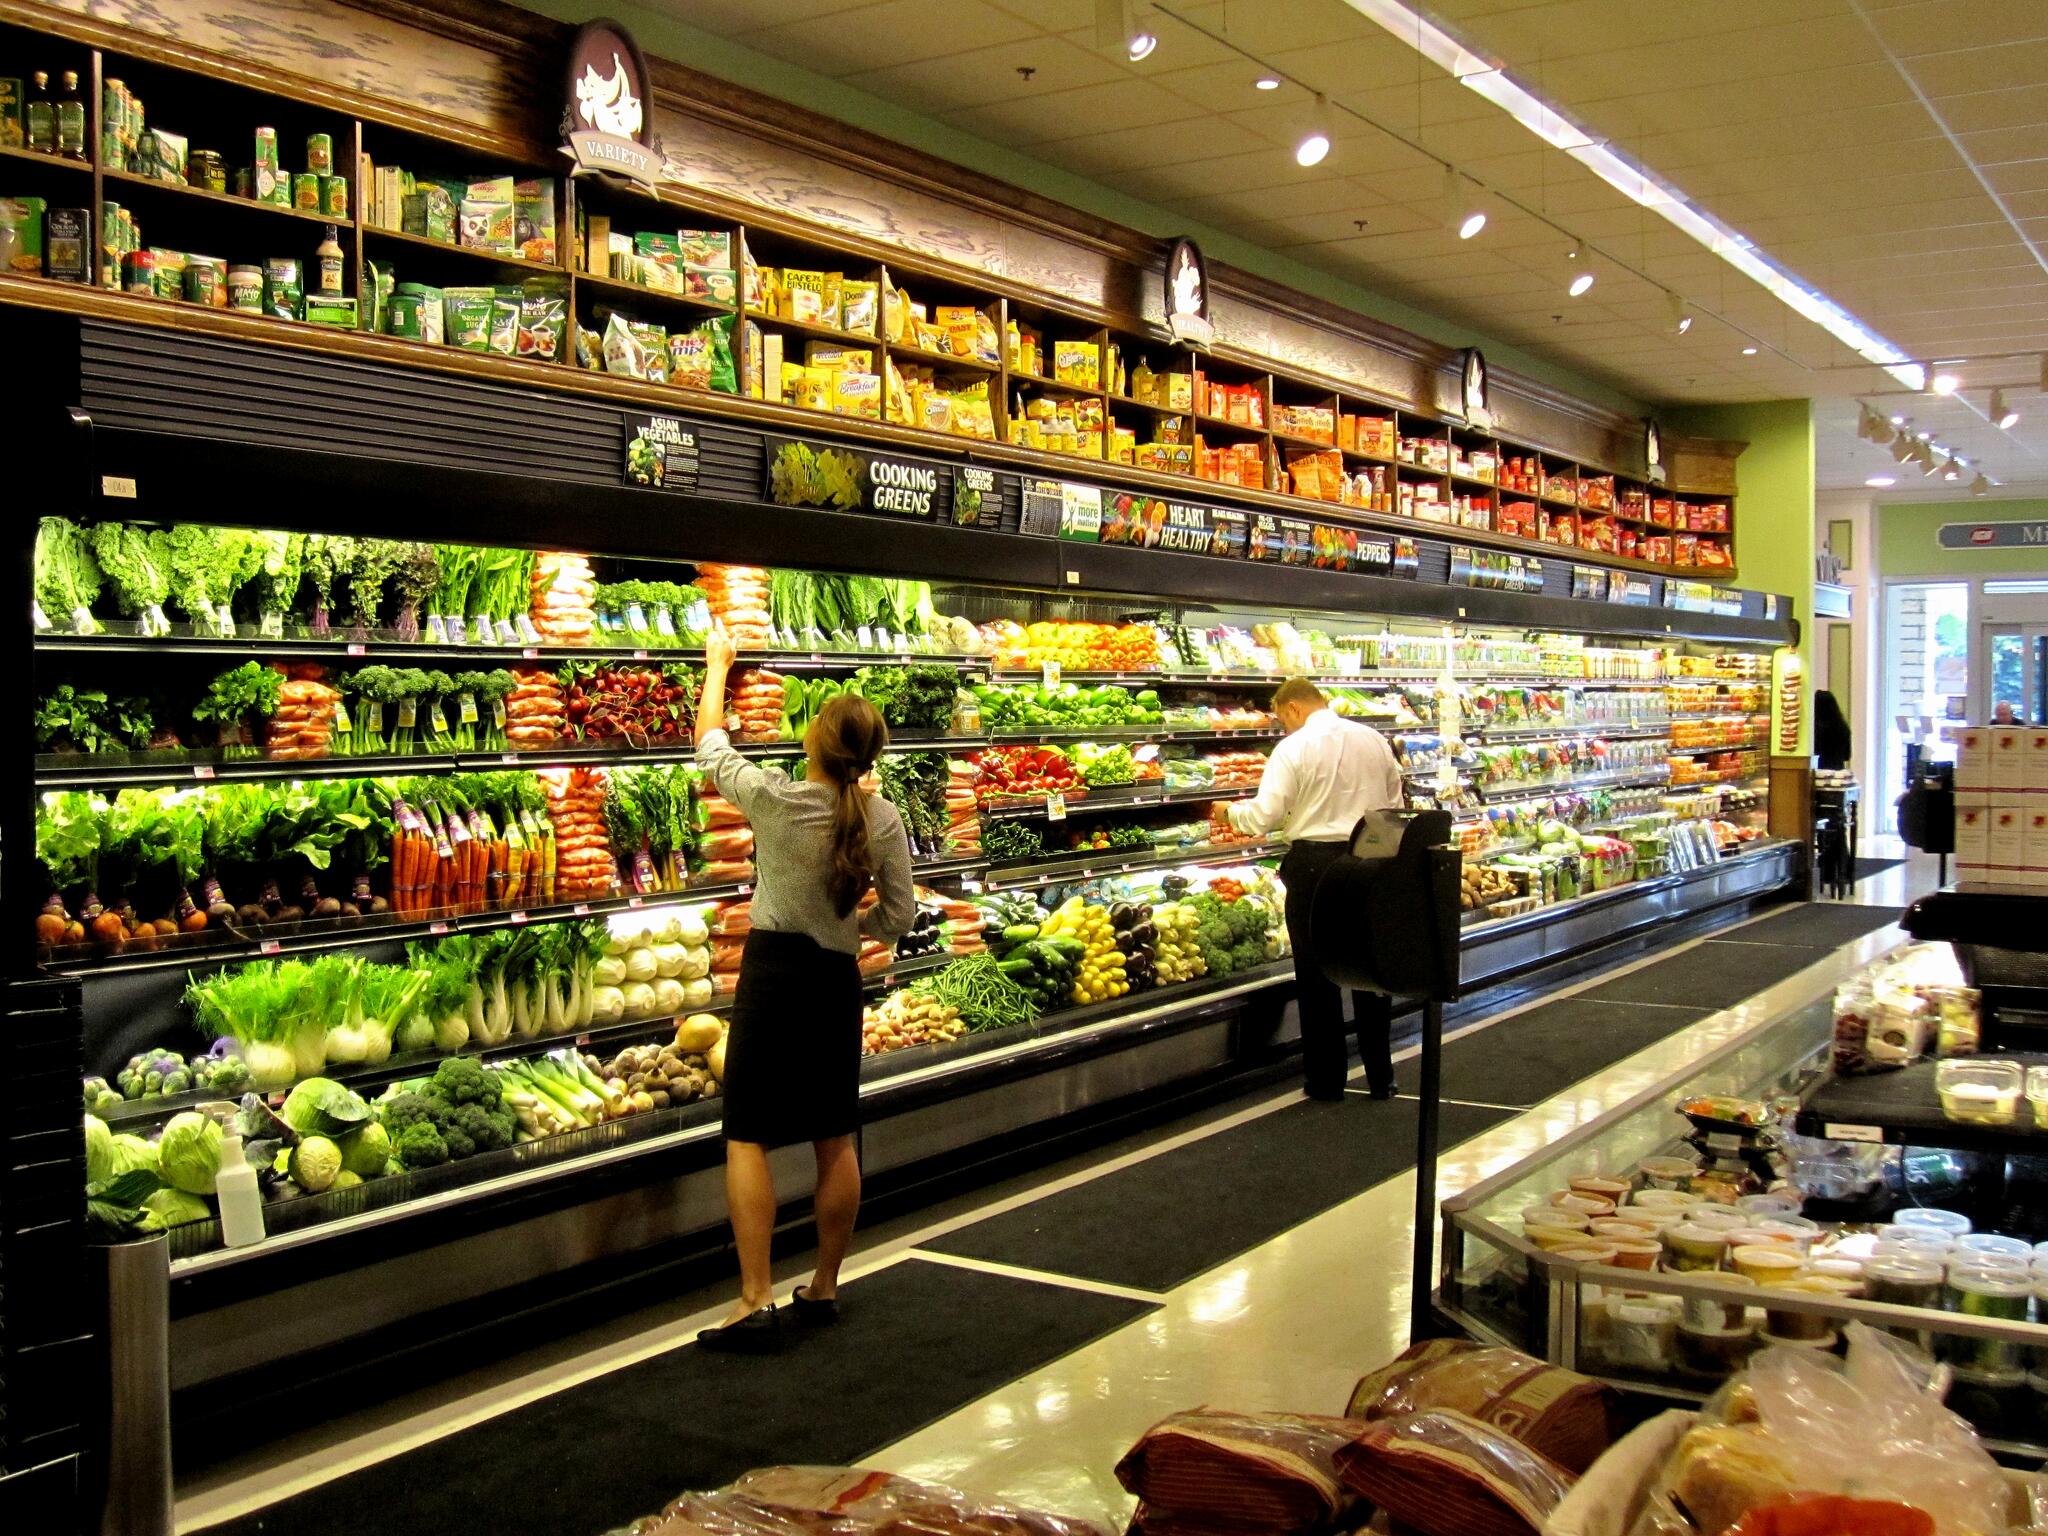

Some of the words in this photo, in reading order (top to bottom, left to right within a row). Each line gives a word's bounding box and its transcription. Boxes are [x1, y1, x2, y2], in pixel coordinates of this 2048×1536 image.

[586, 141, 649, 171] VARIETY
[786, 280, 822, 292] BUSTELO
[234, 287, 261, 301] MAYO
[839, 380, 877, 395] Breakfast
[650, 417, 680, 433] ASIAN
[636, 426, 694, 446] VEGETABLES
[869, 460, 937, 492] COOKING
[963, 467, 995, 482] COOKING
[966, 479, 993, 492] GREENS
[873, 486, 931, 515] GREENS
[1078, 505, 1099, 519] more
[1169, 504, 1205, 528] HEART
[1077, 517, 1099, 528] matters
[1160, 526, 1214, 552] HEALTHY
[1356, 542, 1391, 564] PEPPERS
[1508, 565, 1526, 580] SALAD
[1504, 578, 1525, 592] GREENS
